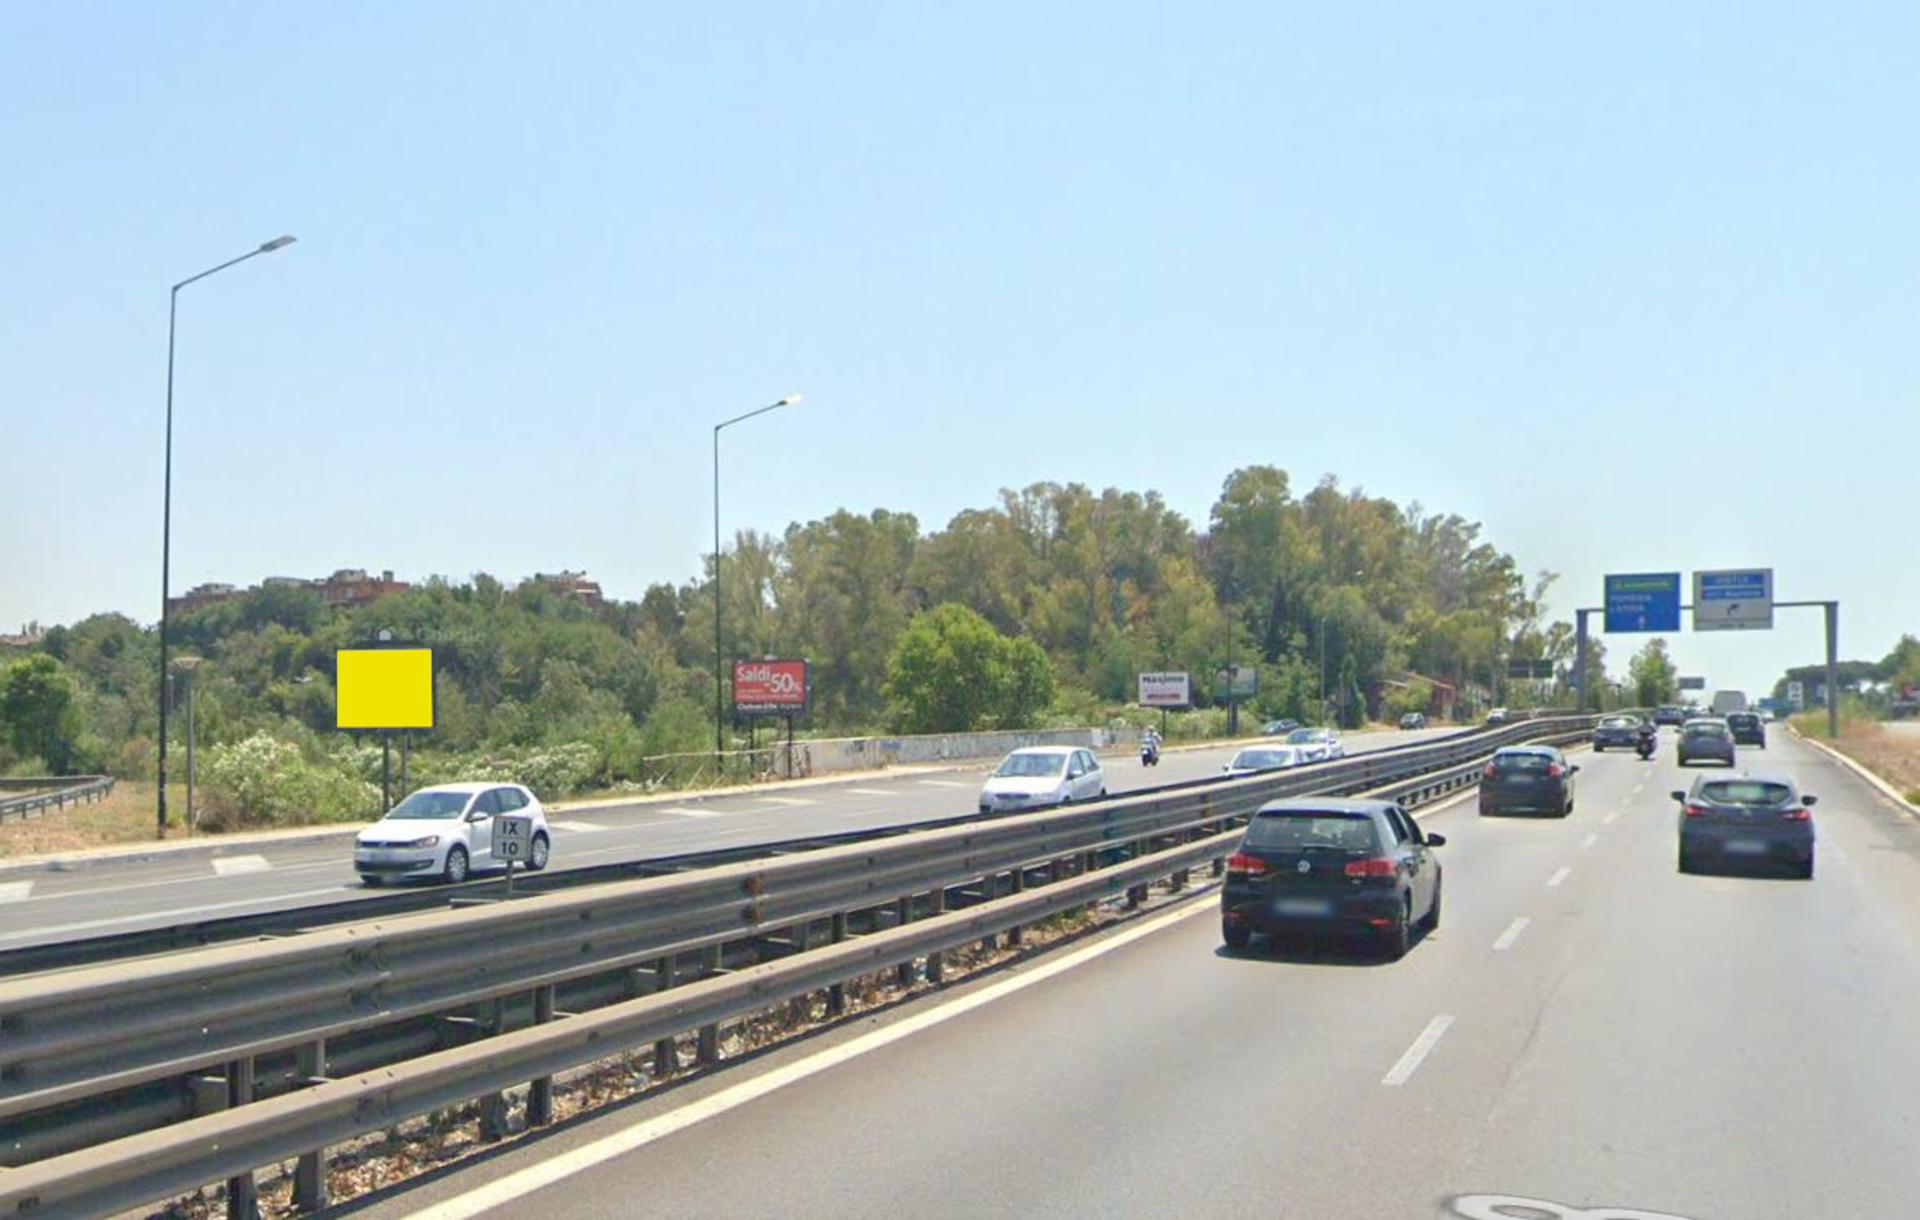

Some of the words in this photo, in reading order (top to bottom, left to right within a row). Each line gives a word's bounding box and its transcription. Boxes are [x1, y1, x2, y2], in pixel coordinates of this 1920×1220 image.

[736, 665, 771, 683] Saldi
[502, 821, 518, 835] IX
[502, 842, 518, 855] 10
